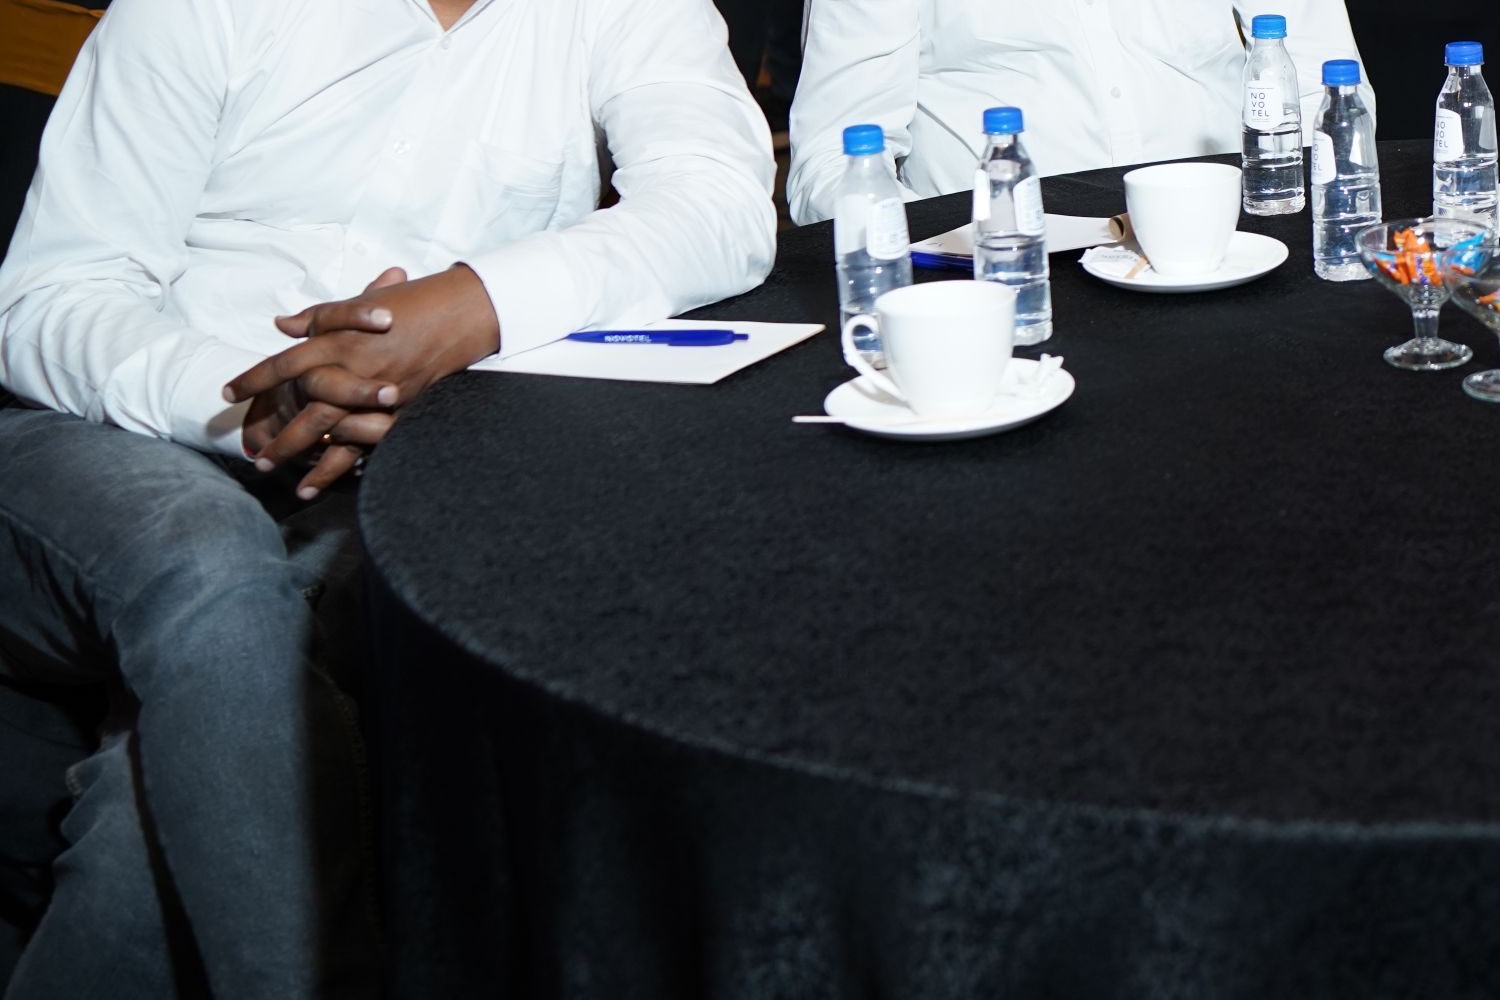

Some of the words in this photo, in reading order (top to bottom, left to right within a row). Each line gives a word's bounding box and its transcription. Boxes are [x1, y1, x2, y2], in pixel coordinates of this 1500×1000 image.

[1250, 92, 1266, 100] NO
[1251, 101, 1265, 109] VO
[1251, 109, 1270, 117] TEL
